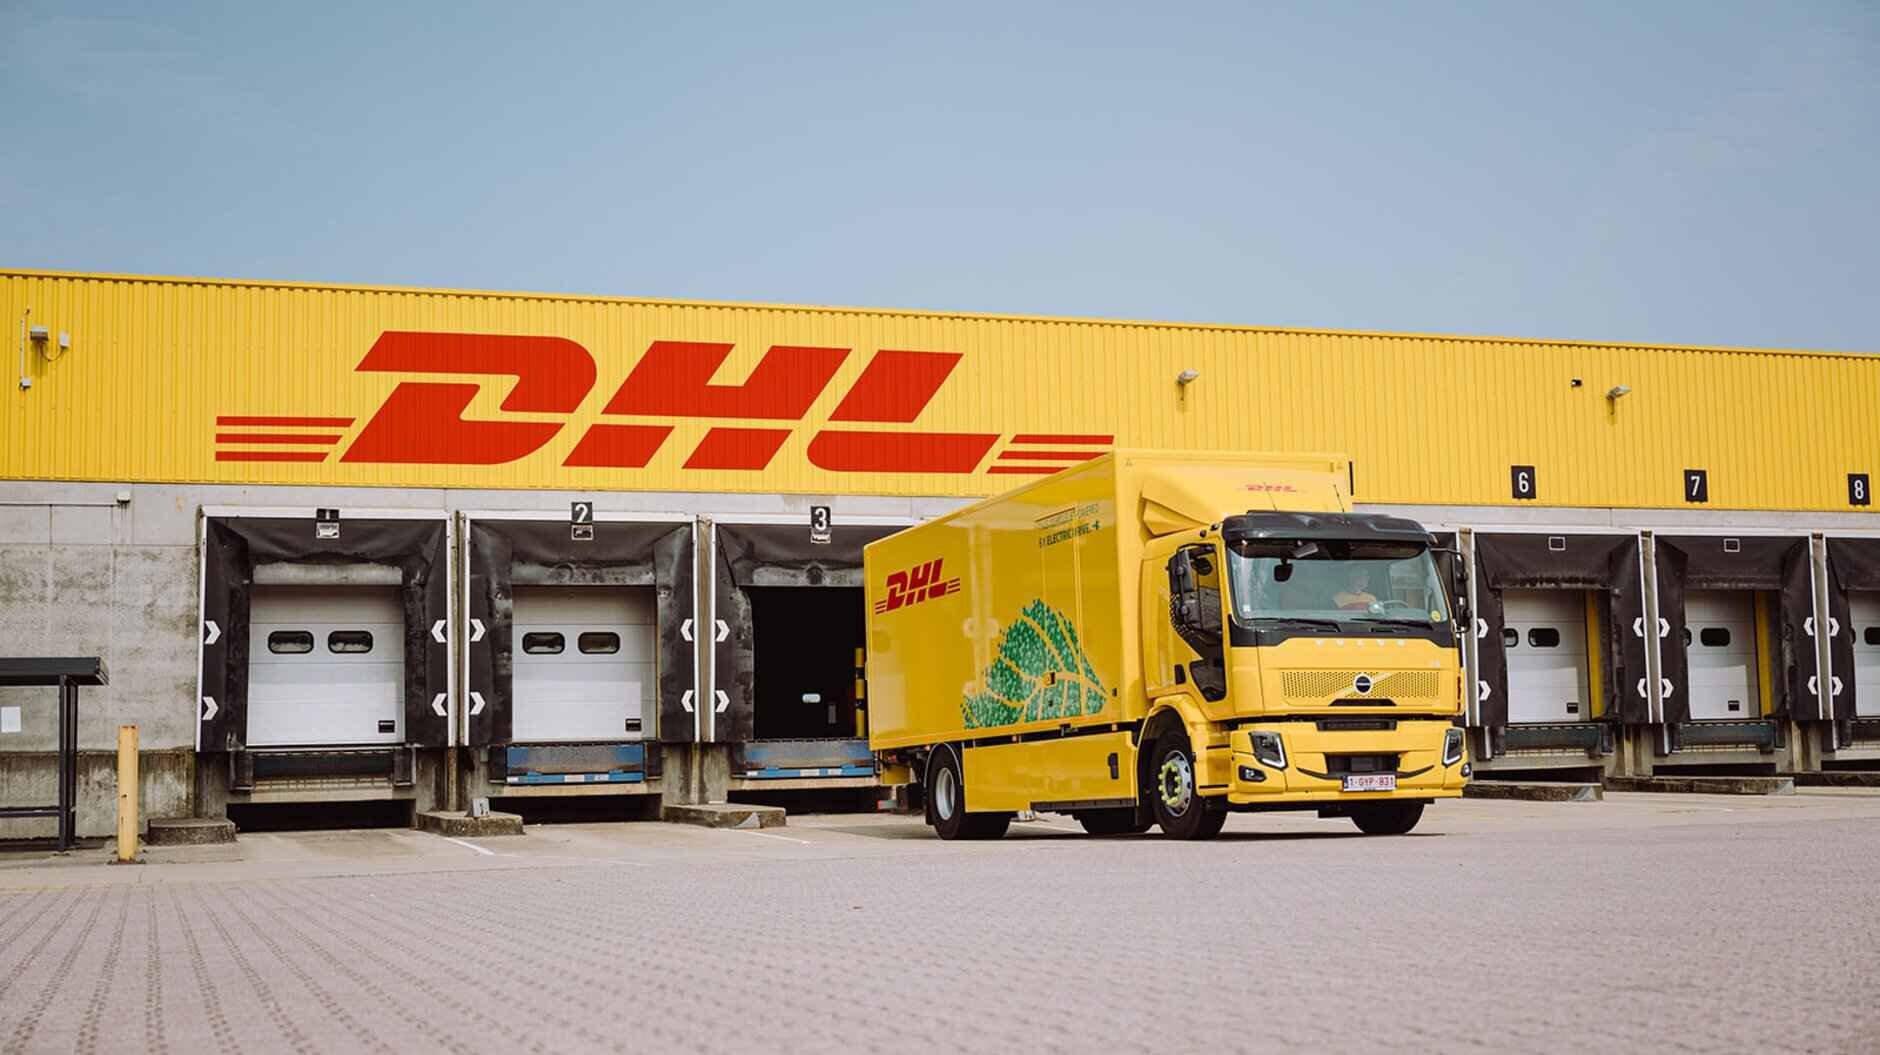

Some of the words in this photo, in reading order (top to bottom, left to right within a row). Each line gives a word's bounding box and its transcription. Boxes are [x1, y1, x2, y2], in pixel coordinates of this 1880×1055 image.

[339, 331, 1001, 474] DHL
[1519, 472, 1529, 493] 6
[1690, 475, 1700, 496] 7
[1854, 480, 1864, 499] 8
[575, 503, 588, 523] 2
[815, 508, 827, 530] 3
[886, 558, 947, 611] DHL
